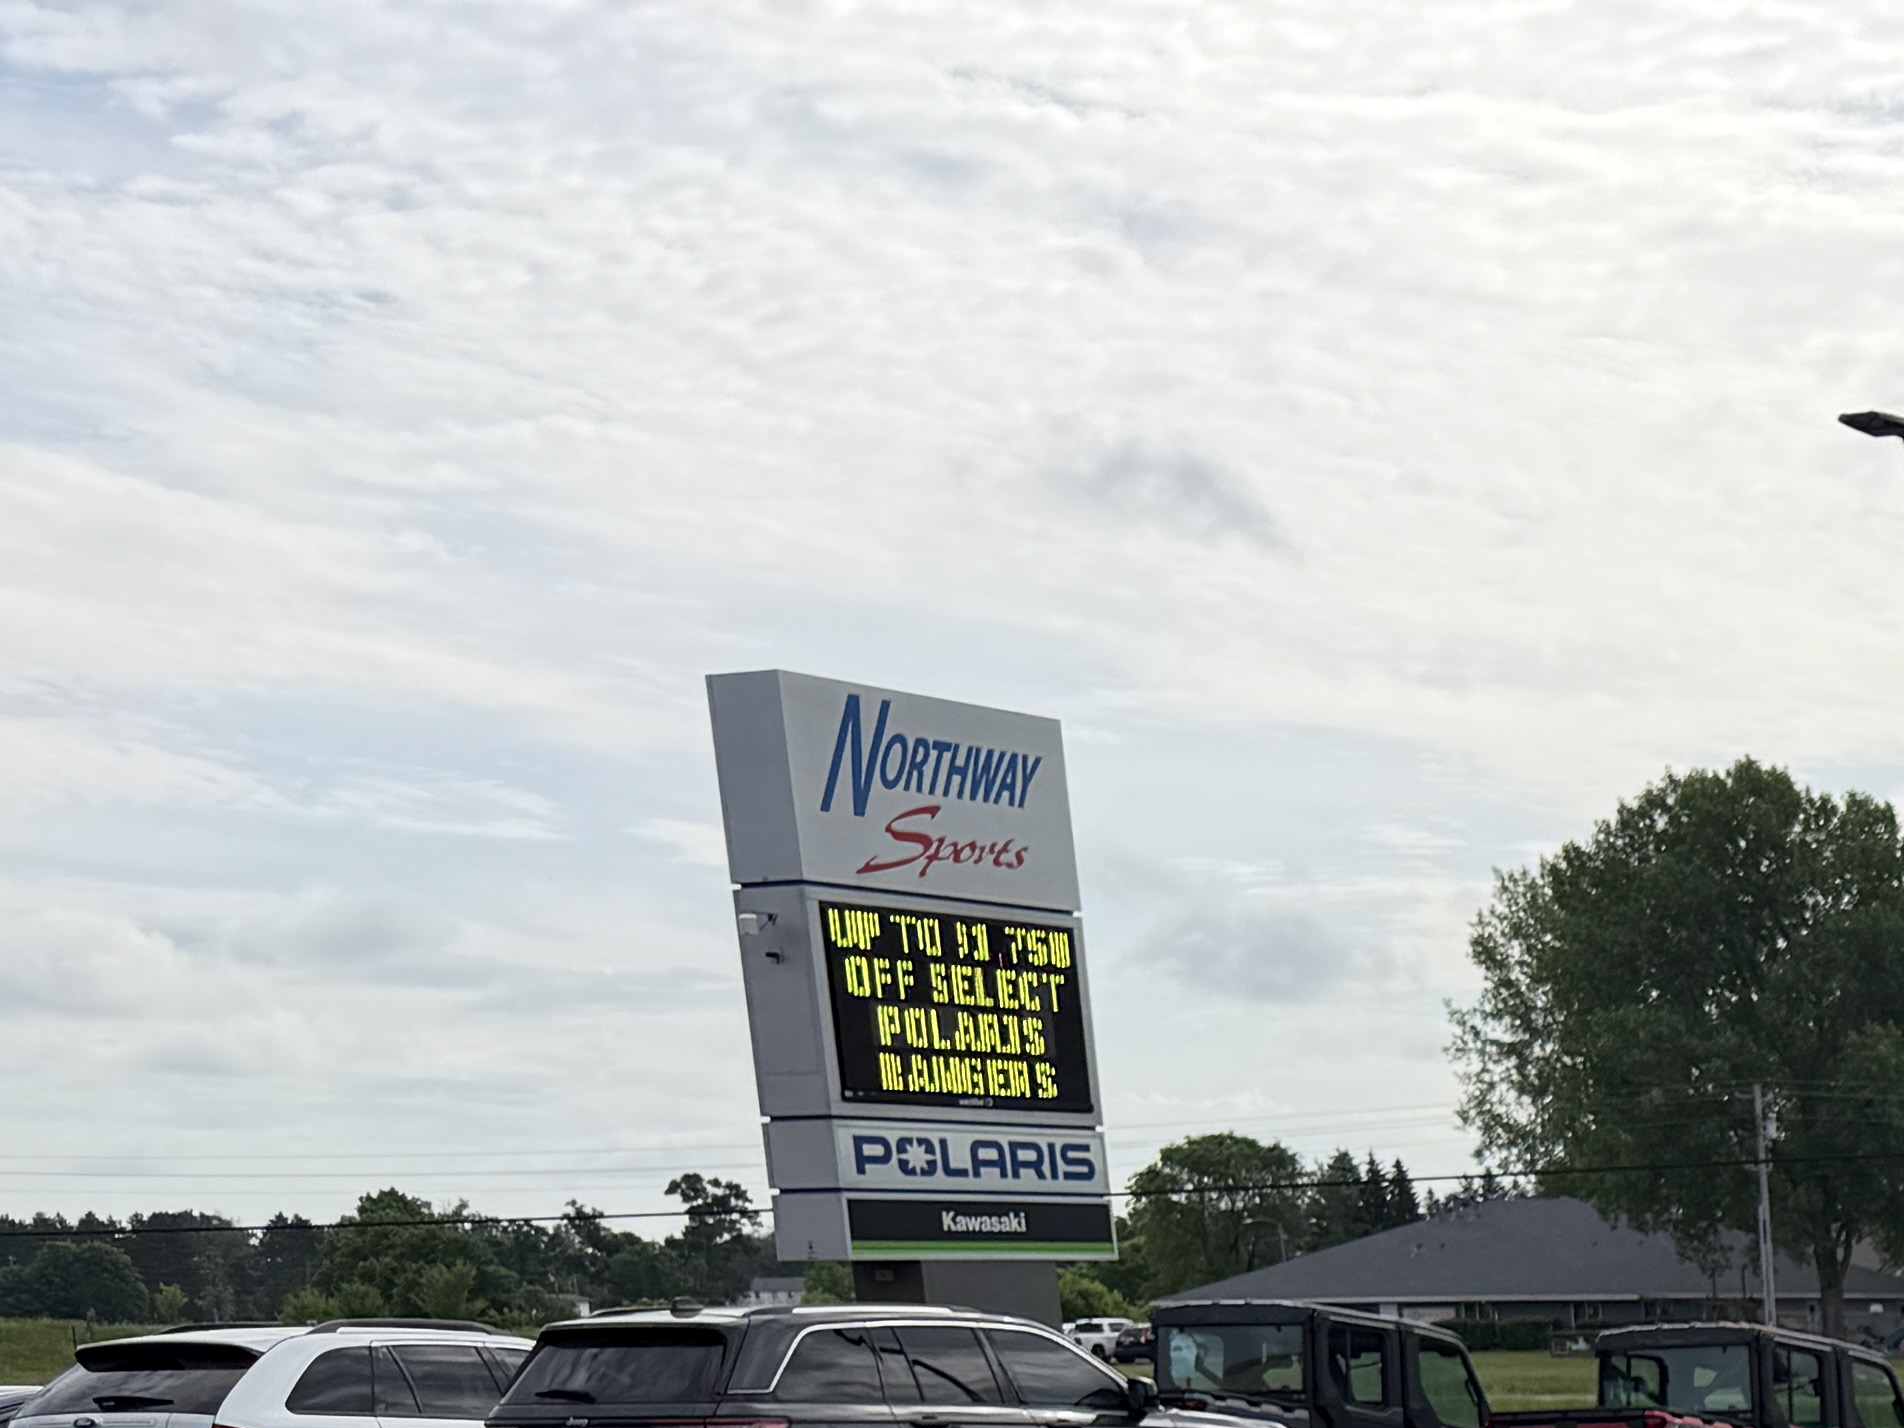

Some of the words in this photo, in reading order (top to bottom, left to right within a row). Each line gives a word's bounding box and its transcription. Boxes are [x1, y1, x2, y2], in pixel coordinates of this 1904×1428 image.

[856, 805, 1028, 878] Sports
[828, 908, 880, 949] UP
[890, 915, 941, 956] TO
[845, 955, 914, 999] OFF
[930, 963, 1065, 1012] SELECT
[877, 1005, 1045, 1055] POLARIS
[879, 1052, 1058, 1098] RANGERS
[852, 1134, 1096, 1181] POLARIS
[941, 1210, 1027, 1233] Kawasaki
